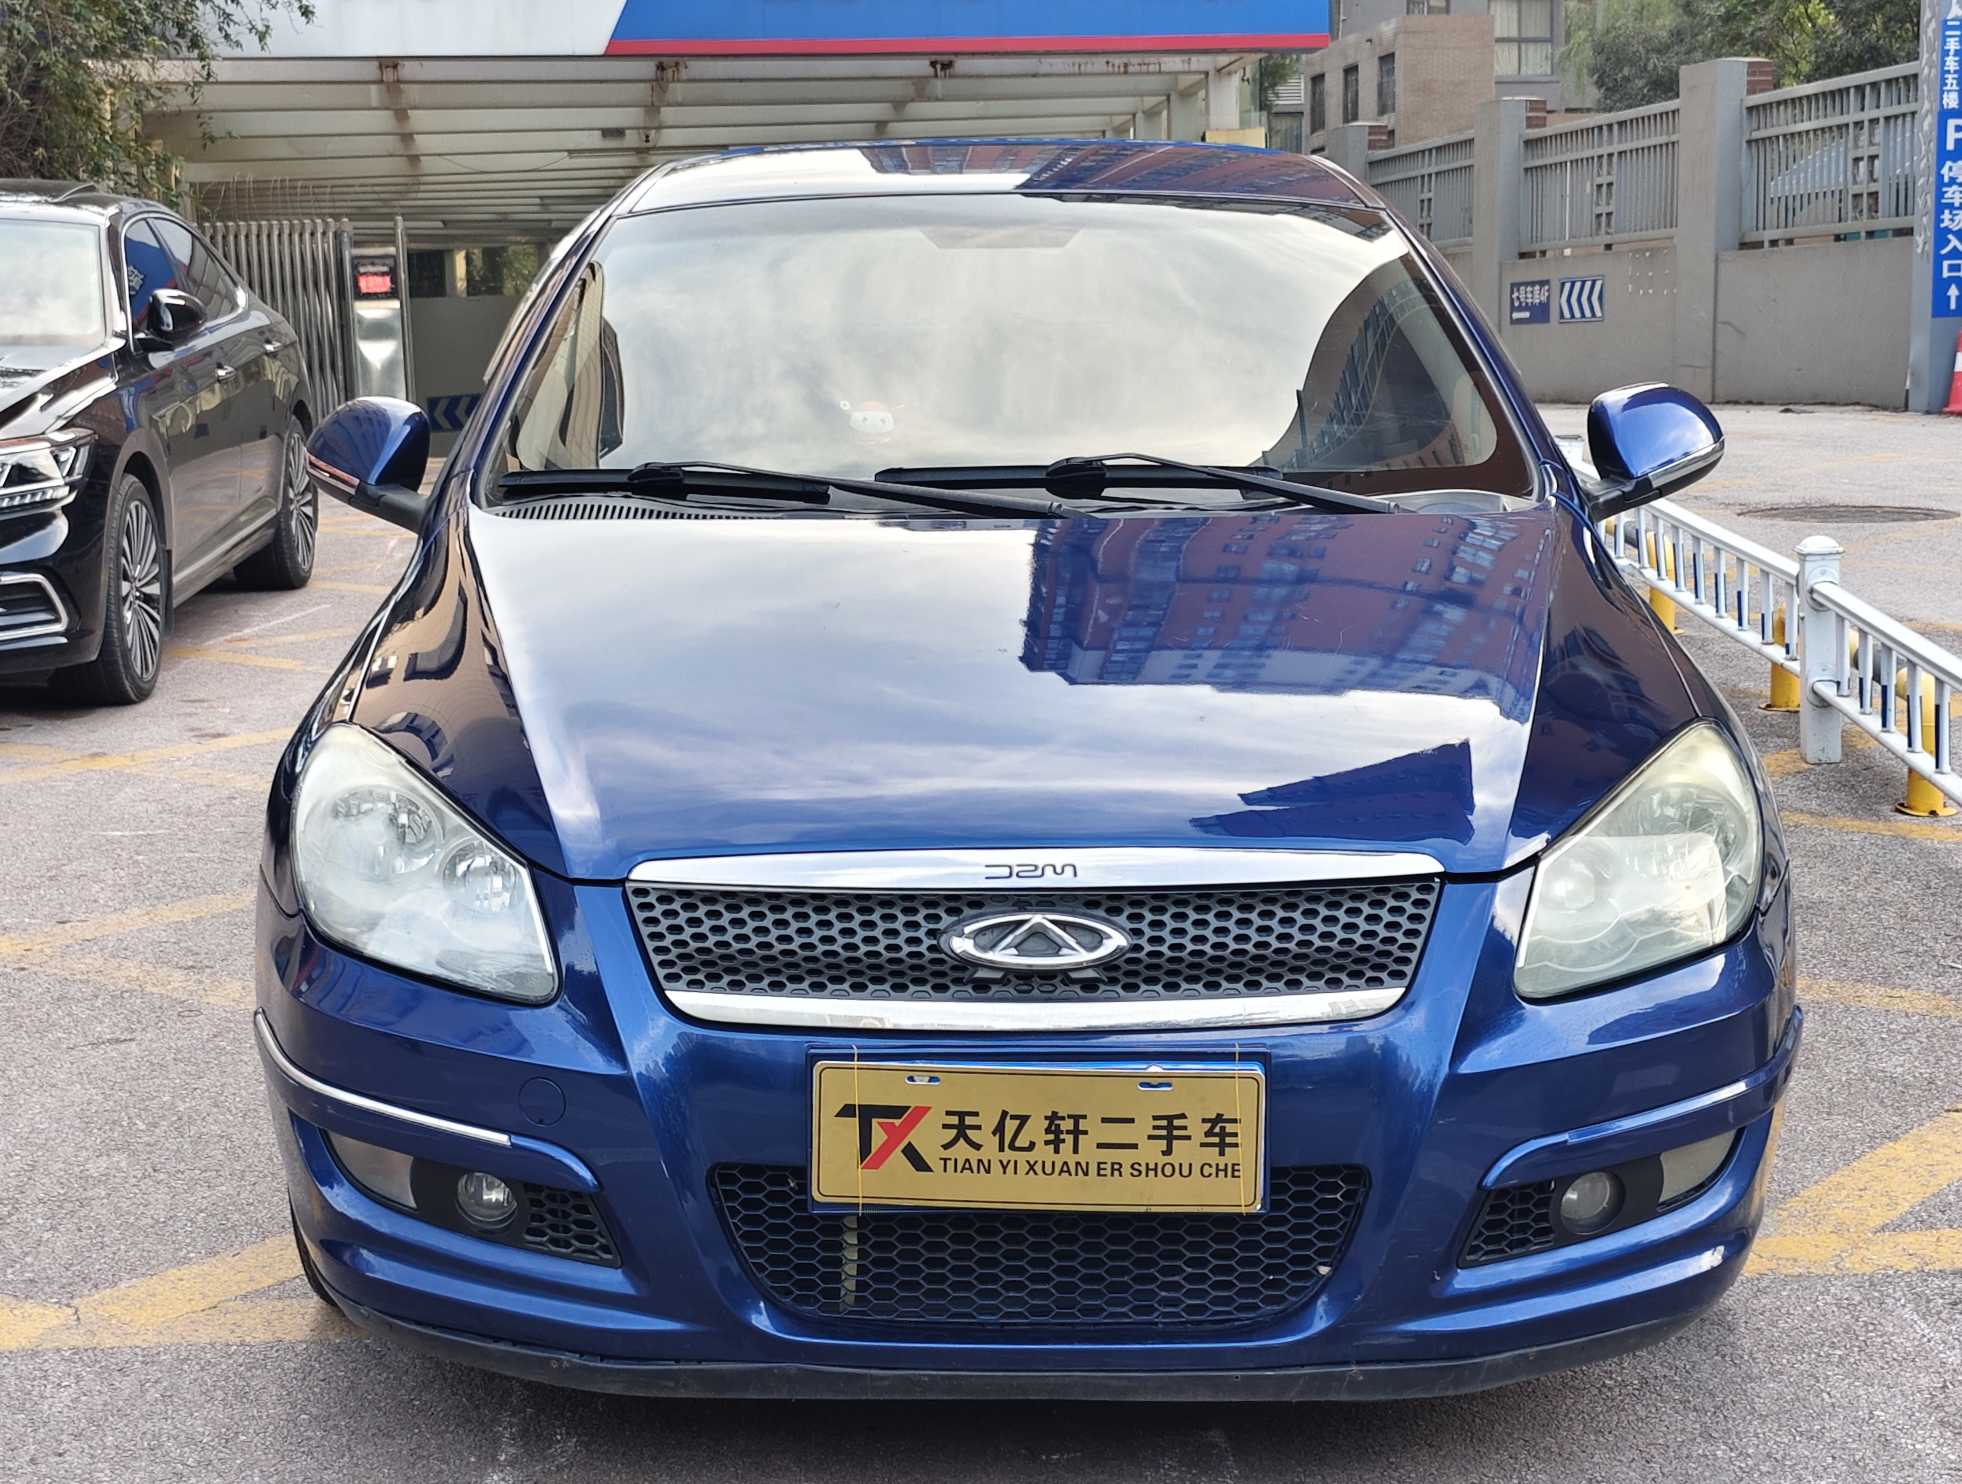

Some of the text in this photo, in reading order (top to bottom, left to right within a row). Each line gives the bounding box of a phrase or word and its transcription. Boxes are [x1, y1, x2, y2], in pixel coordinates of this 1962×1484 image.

[1942, 20, 1961, 109] 二手车五楼
[1939, 160, 1962, 279] 停车场入口
[939, 1109, 1242, 1157] 天亿轩二手车
[939, 1157, 1241, 1179] TIAN YI XUAN ER SHOU CHE
